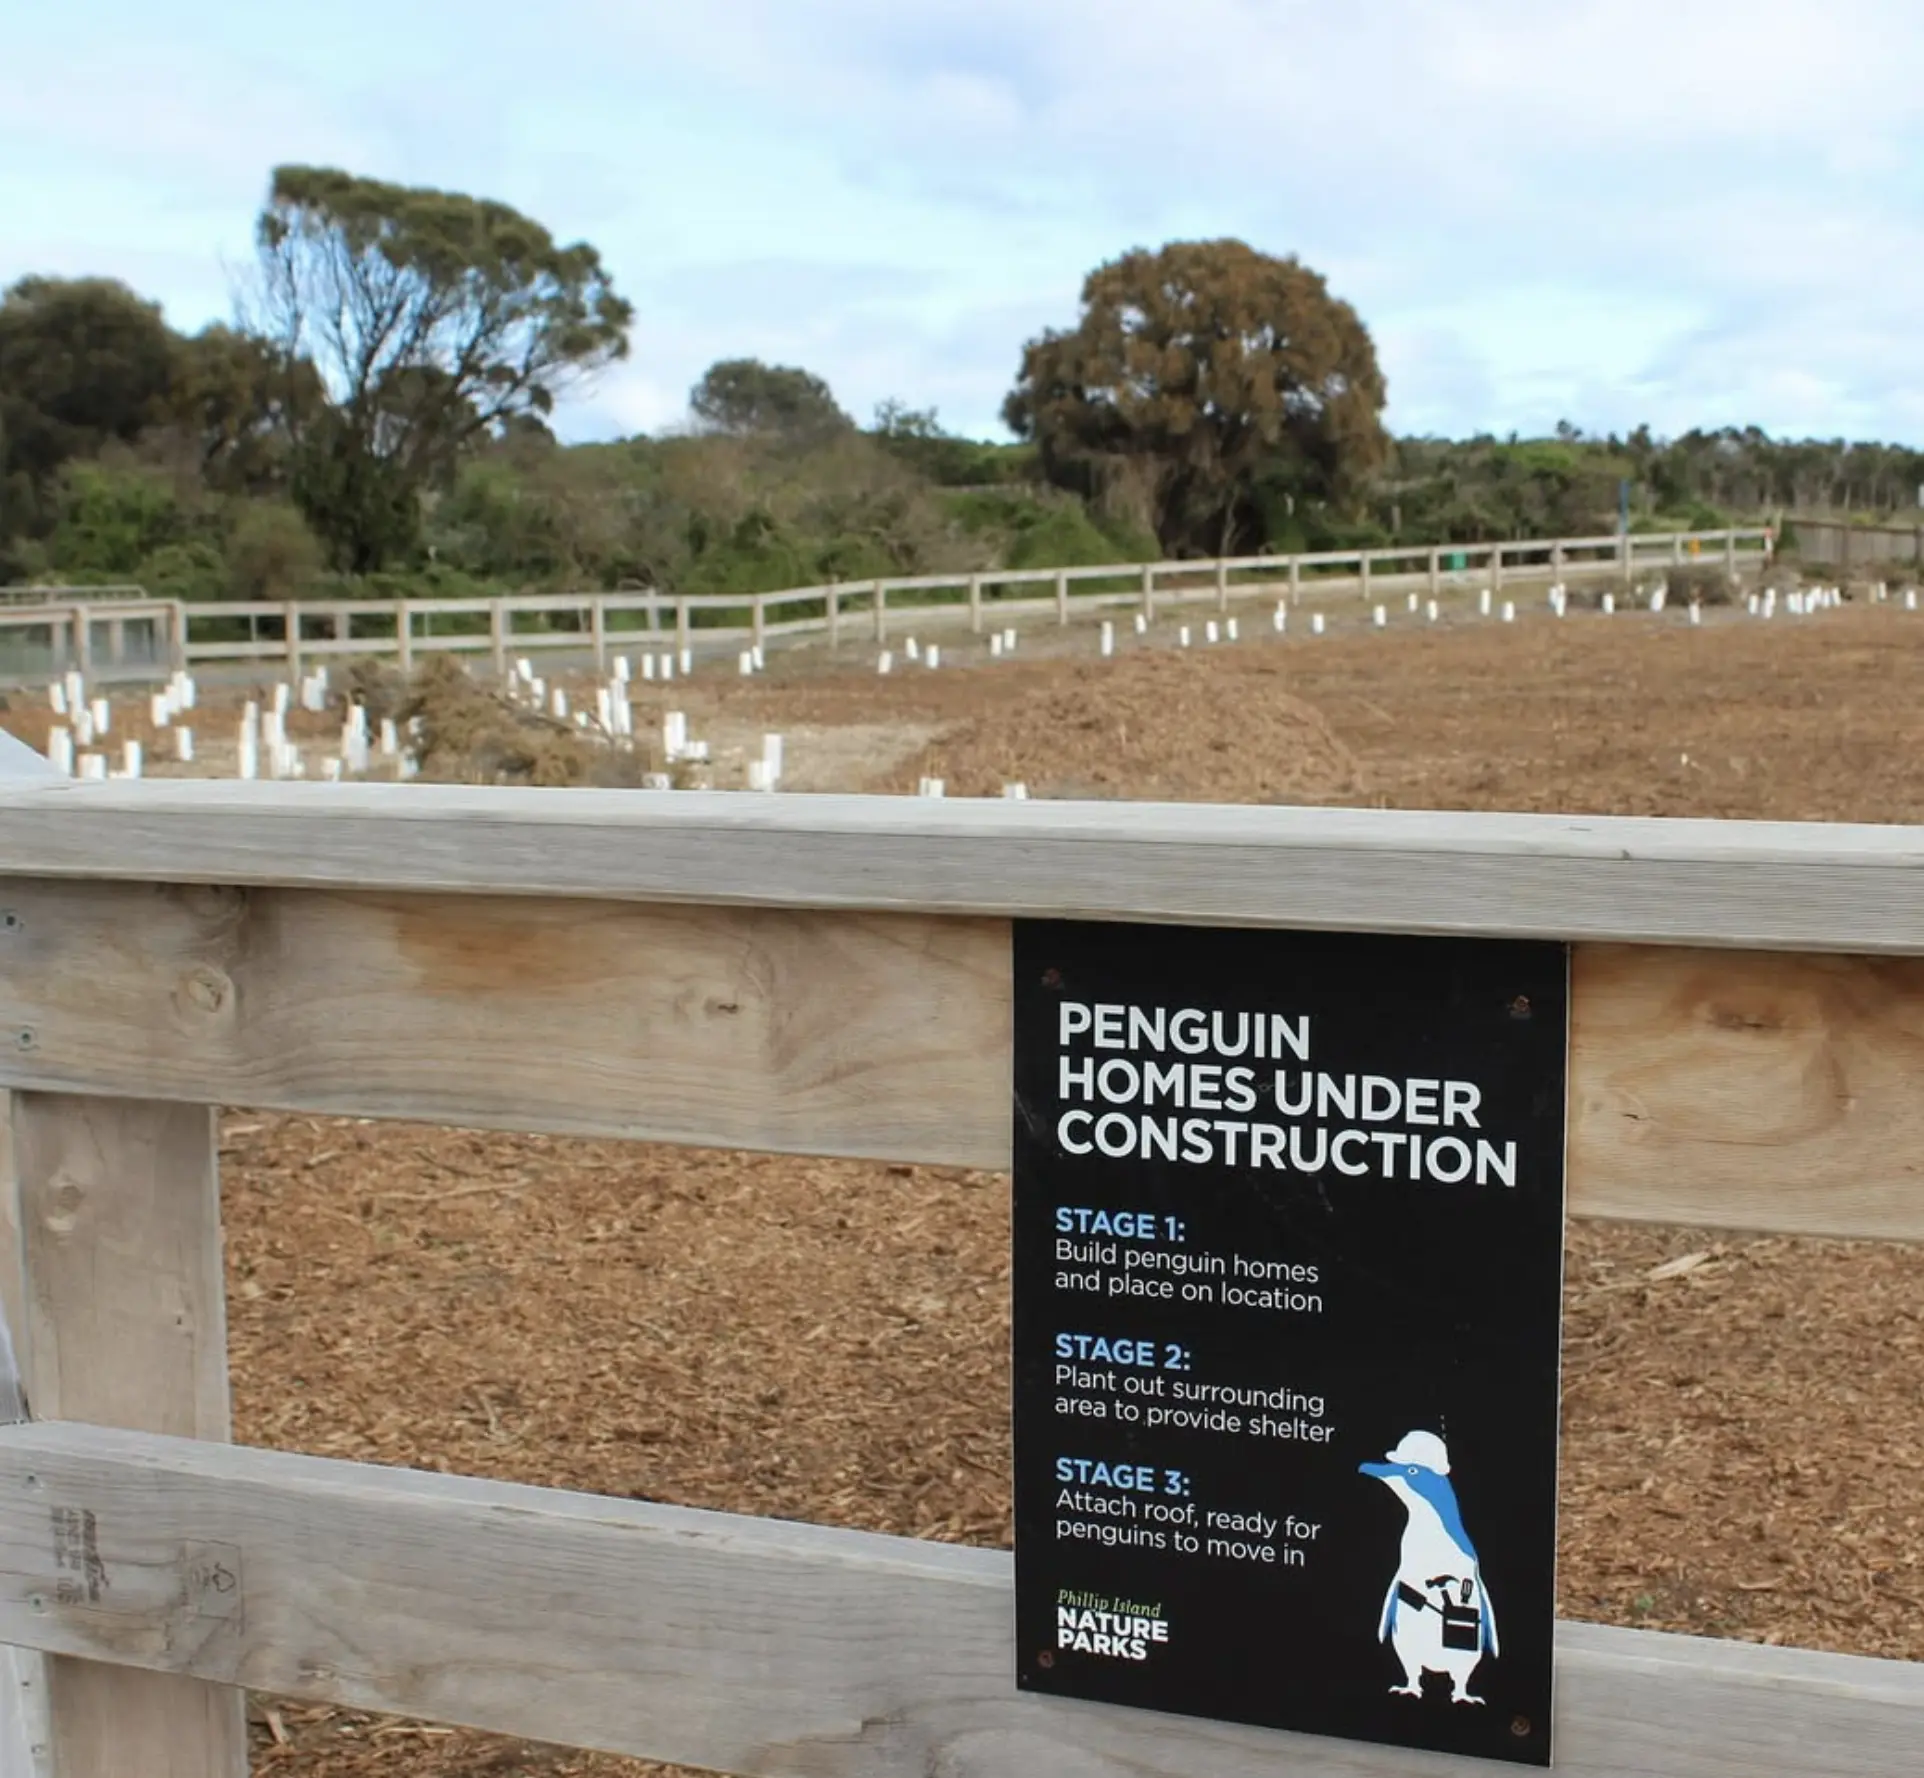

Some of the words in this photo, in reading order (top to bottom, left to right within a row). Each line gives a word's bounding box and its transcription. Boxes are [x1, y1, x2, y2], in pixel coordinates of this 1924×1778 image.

[1060, 1002, 1309, 1060] PENGUIN
[1060, 1056, 1256, 1112] HOMES
[1275, 1070, 1481, 1128] UNDER
[1058, 1110, 1516, 1187] CONSTRUCTION
[1056, 1207, 1155, 1239] STAGE
[1165, 1216, 1185, 1242] 1:
[1056, 1239, 1117, 1265] Build
[1125, 1250, 1225, 1275] penguin
[1234, 1254, 1319, 1284] homes
[1055, 1270, 1100, 1292] and
[1109, 1273, 1173, 1299] place
[1182, 1284, 1213, 1302] on
[1222, 1282, 1323, 1313] location
[1056, 1333, 1154, 1366] STAGE
[1164, 1344, 1191, 1371] 2:
[1056, 1365, 1116, 1391] Plant
[1124, 1376, 1165, 1397] out
[1173, 1382, 1325, 1418] surrounding
[1055, 1397, 1107, 1418] area
[1115, 1400, 1140, 1422] to
[1147, 1408, 1242, 1433] provide
[1249, 1415, 1335, 1443] shelter
[1056, 1456, 1155, 1492] STAGE
[1164, 1470, 1190, 1497] 3:
[1056, 1489, 1137, 1518] Attach
[1144, 1503, 1199, 1529] roof,
[1208, 1512, 1278, 1539] ready
[1286, 1516, 1322, 1540] for
[1056, 1520, 1167, 1549] penguins
[1174, 1531, 1200, 1553] to
[1208, 1539, 1276, 1563] move
[1284, 1542, 1305, 1567] in
[1057, 1589, 1109, 1612] Phillip
[1112, 1597, 1161, 1618] Island
[1058, 1607, 1168, 1642] NATURE
[1058, 1627, 1147, 1660] PARKS
